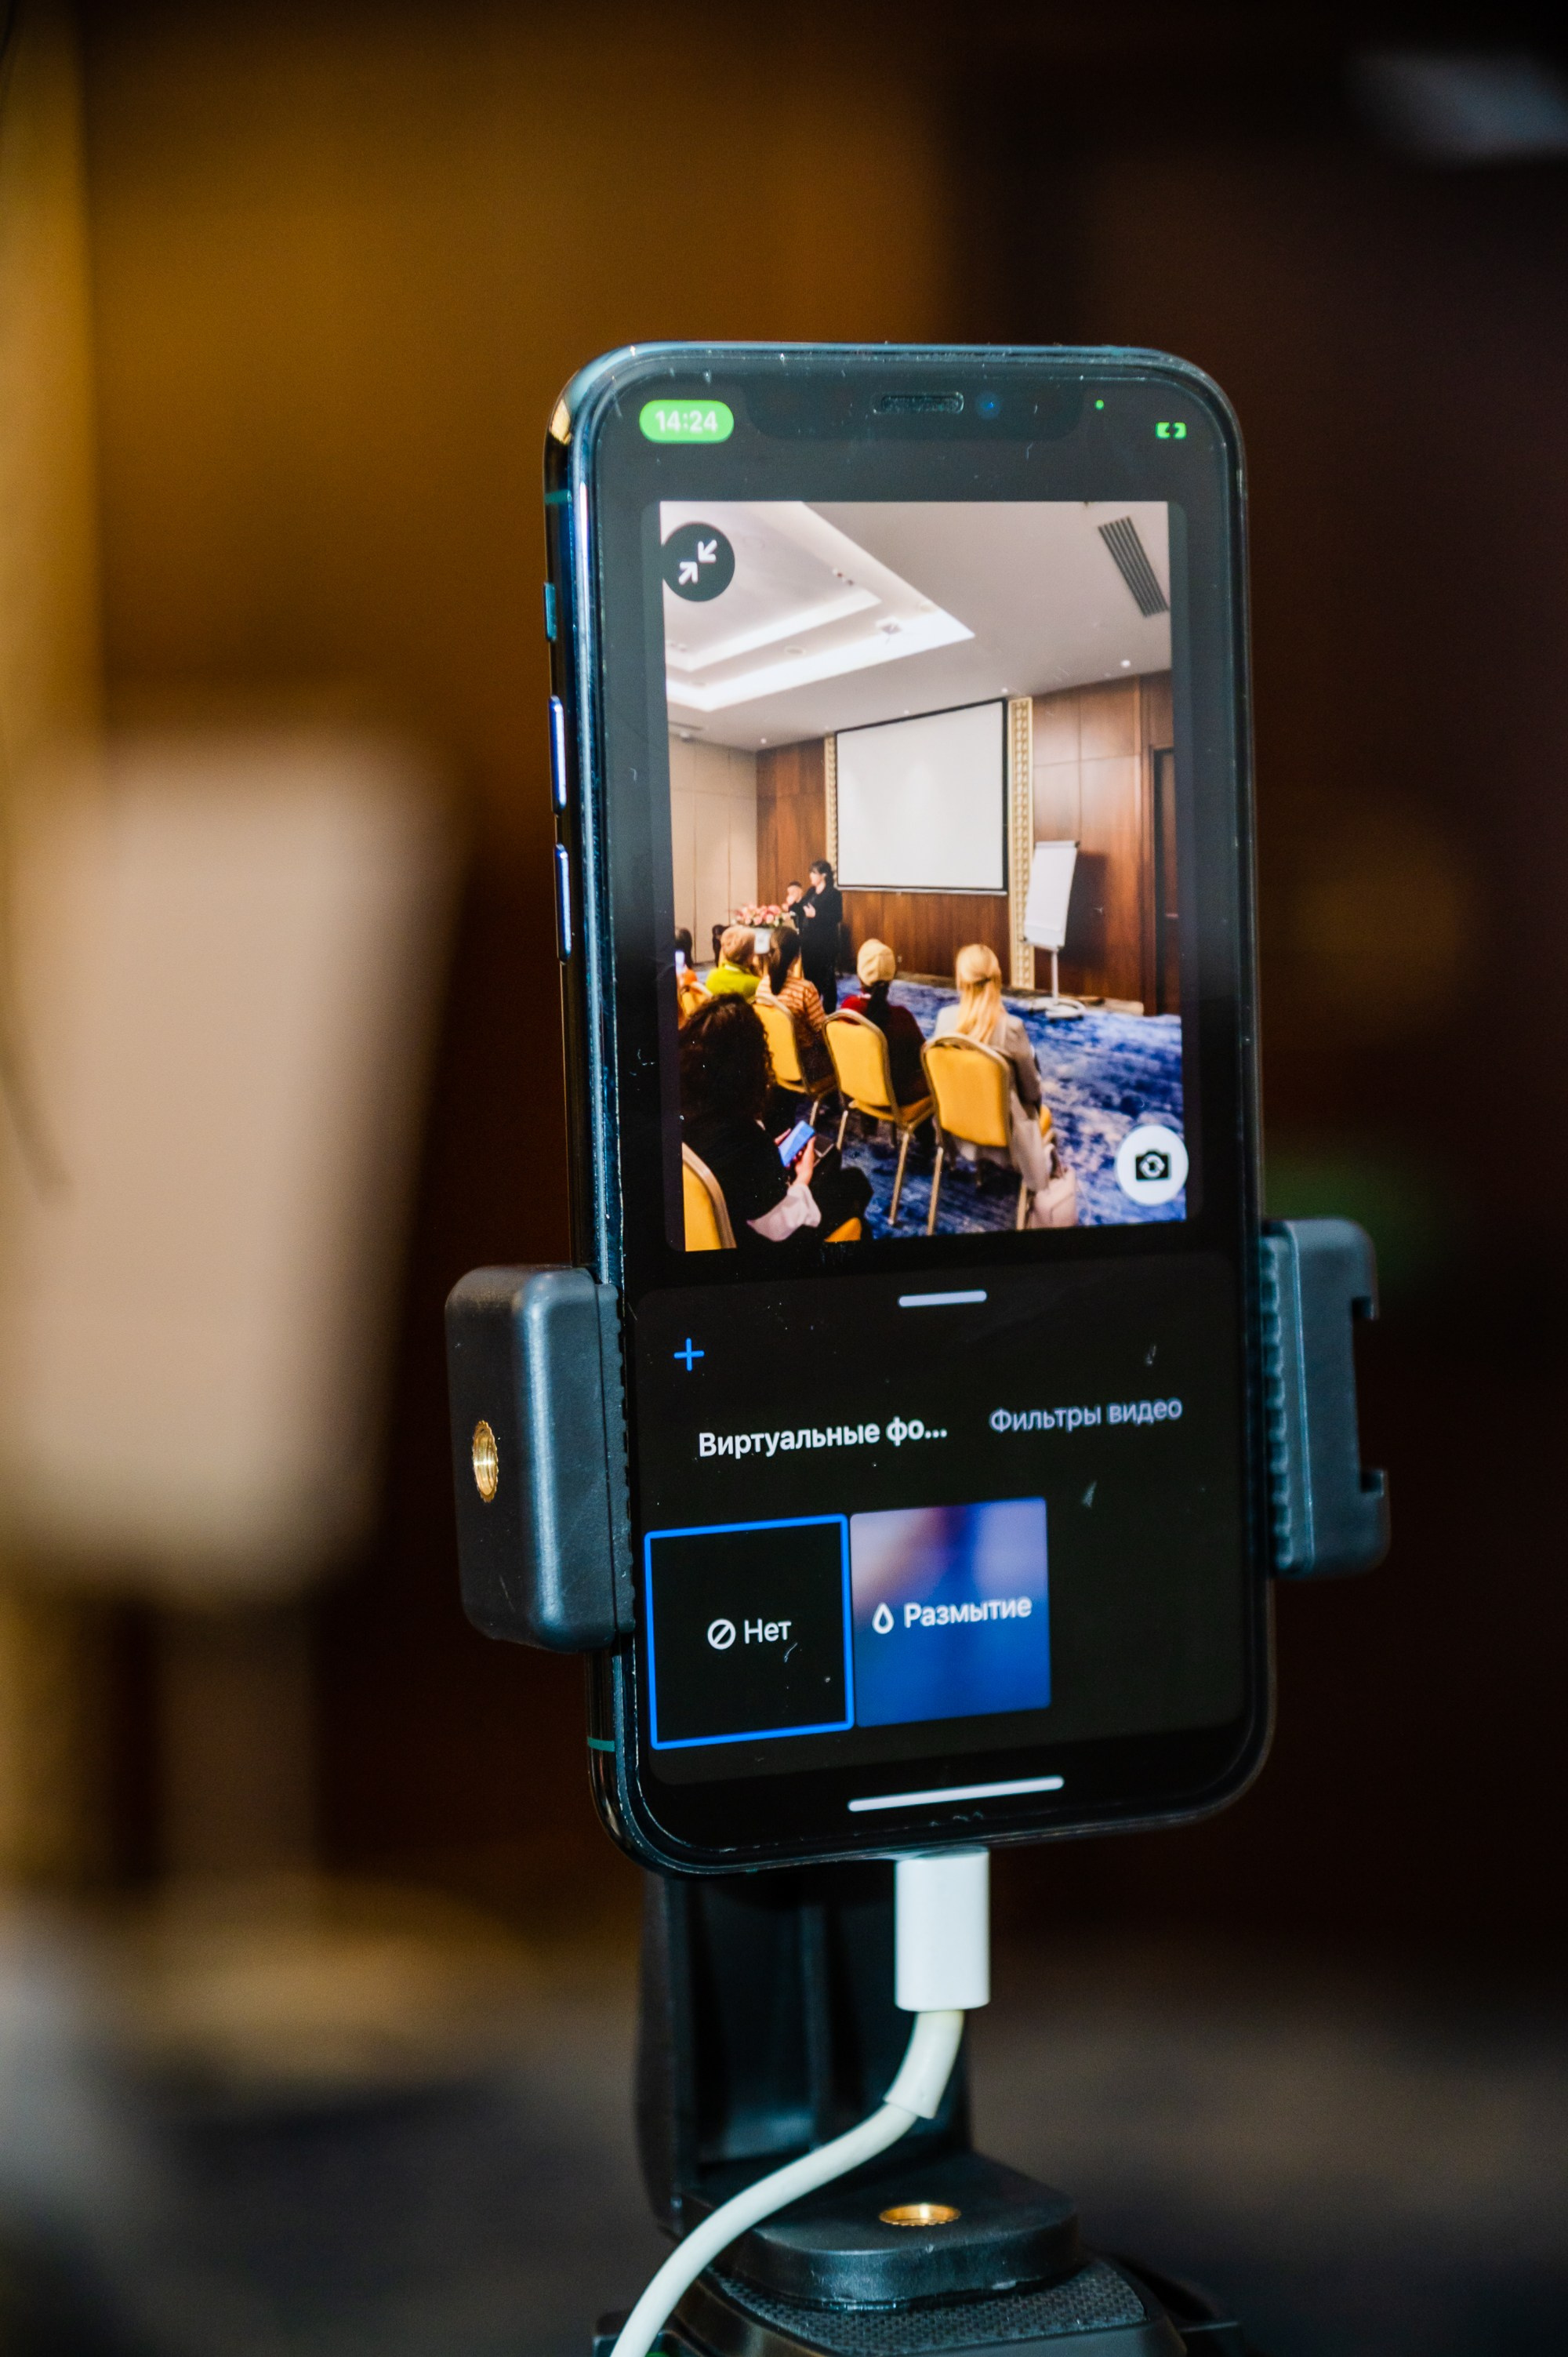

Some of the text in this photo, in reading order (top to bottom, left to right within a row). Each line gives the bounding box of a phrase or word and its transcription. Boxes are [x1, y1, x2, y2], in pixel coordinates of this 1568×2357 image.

[655, 409, 719, 434] 14:24
[989, 1398, 1183, 1433] Фильтры видео
[699, 1422, 880, 1459] Виртуальные
[903, 1596, 1033, 1629] Размытие
[744, 1618, 792, 1644] Нет
